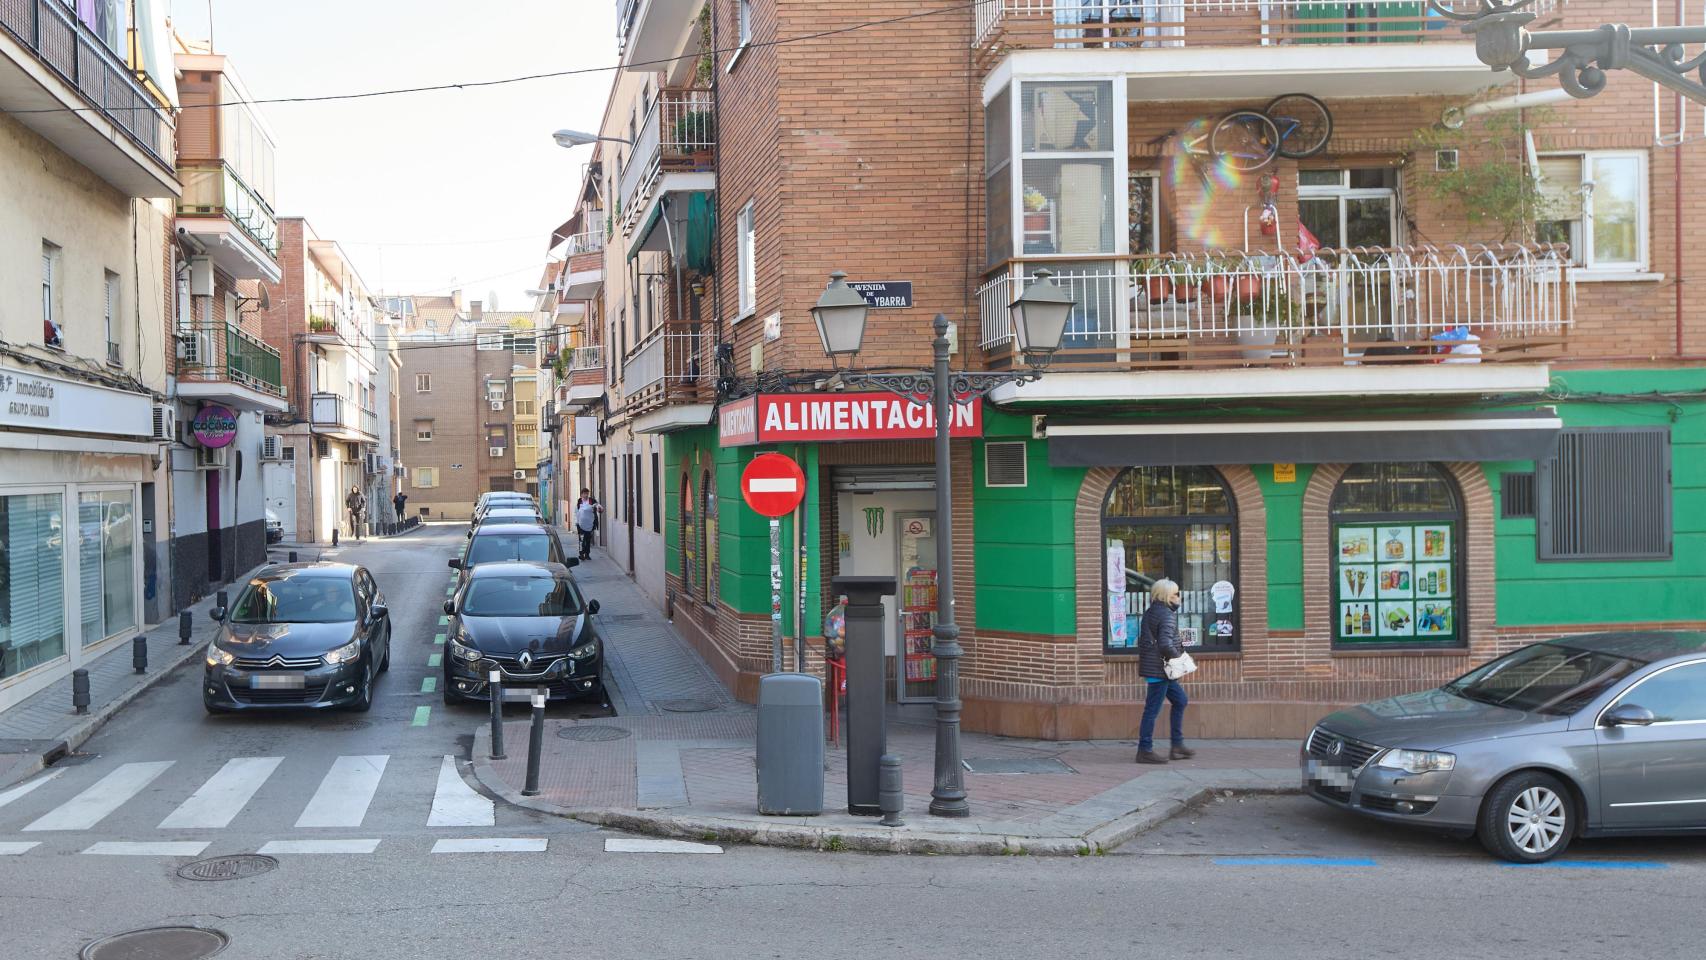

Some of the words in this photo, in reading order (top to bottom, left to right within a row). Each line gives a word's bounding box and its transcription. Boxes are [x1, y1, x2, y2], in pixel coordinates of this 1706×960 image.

[874, 296, 906, 307] YBARRA
[16, 378, 54, 399] Inmobiliaria
[9, 401, 28, 415] GRUPO
[764, 400, 974, 431] ALIMENTACIN
